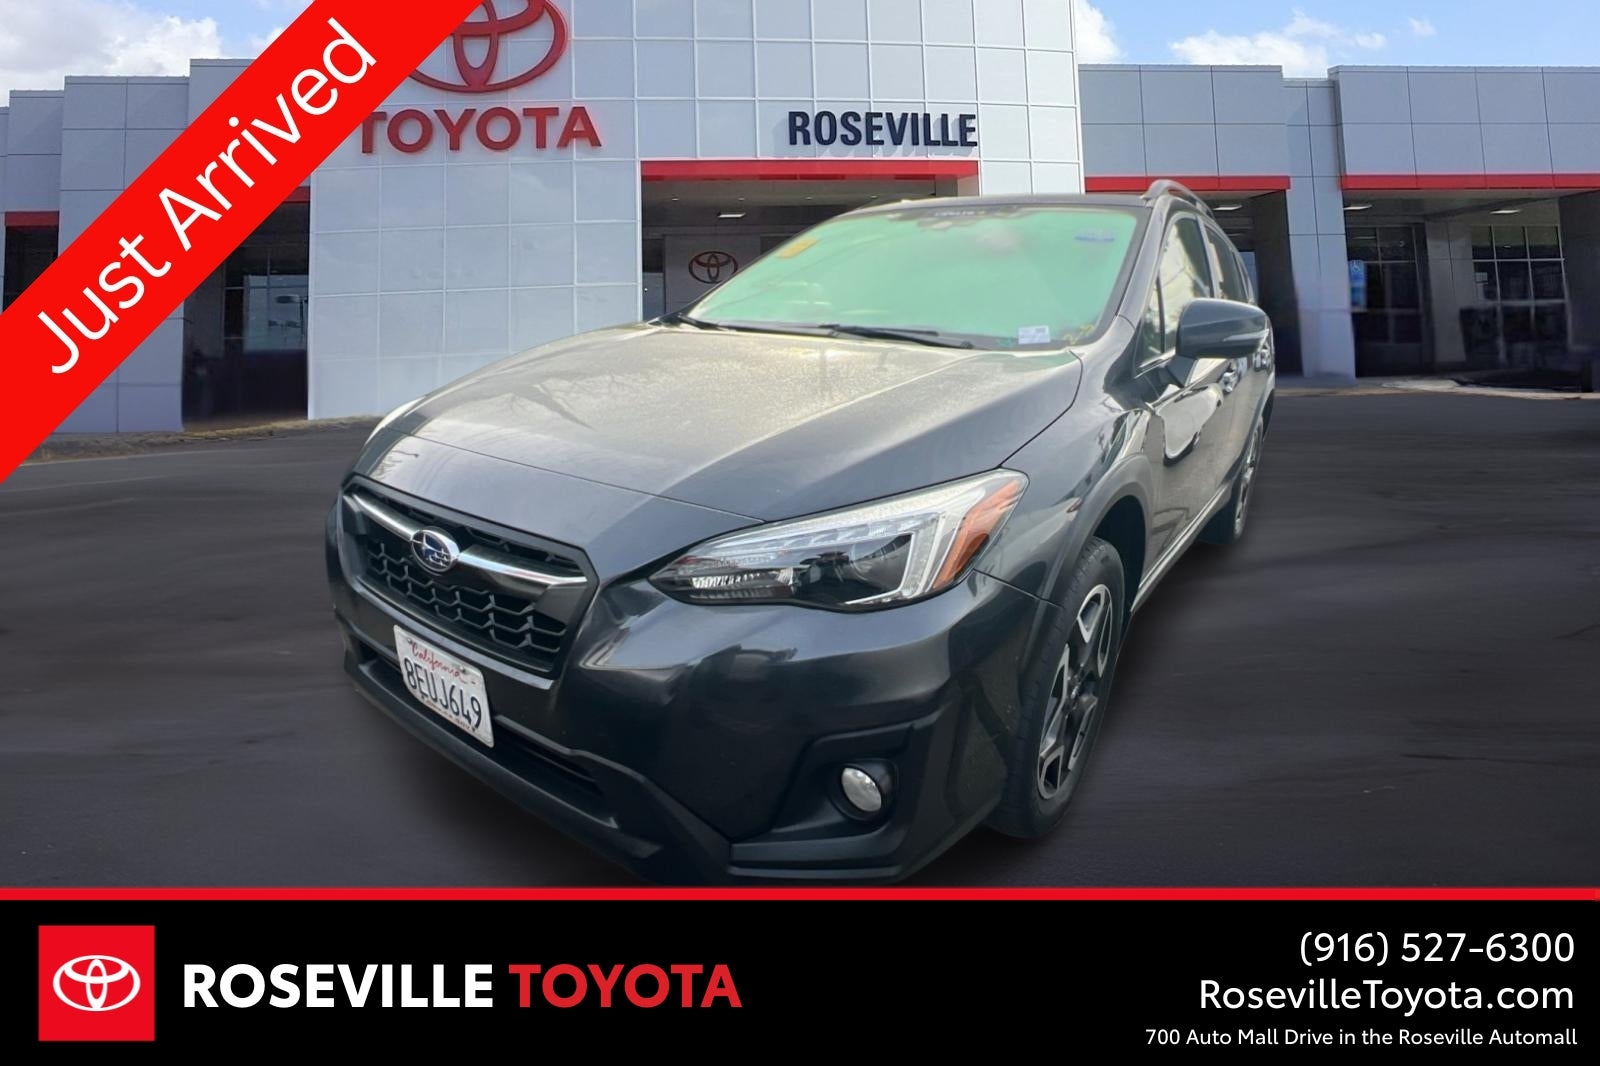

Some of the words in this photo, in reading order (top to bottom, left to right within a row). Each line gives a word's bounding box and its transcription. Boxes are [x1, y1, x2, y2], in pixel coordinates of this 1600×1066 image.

[362, 106, 602, 154] TOYOTA
[788, 110, 978, 147] ROSEVILLE
[411, 642, 463, 680] California
[404, 657, 482, 729] 8EUJ649
